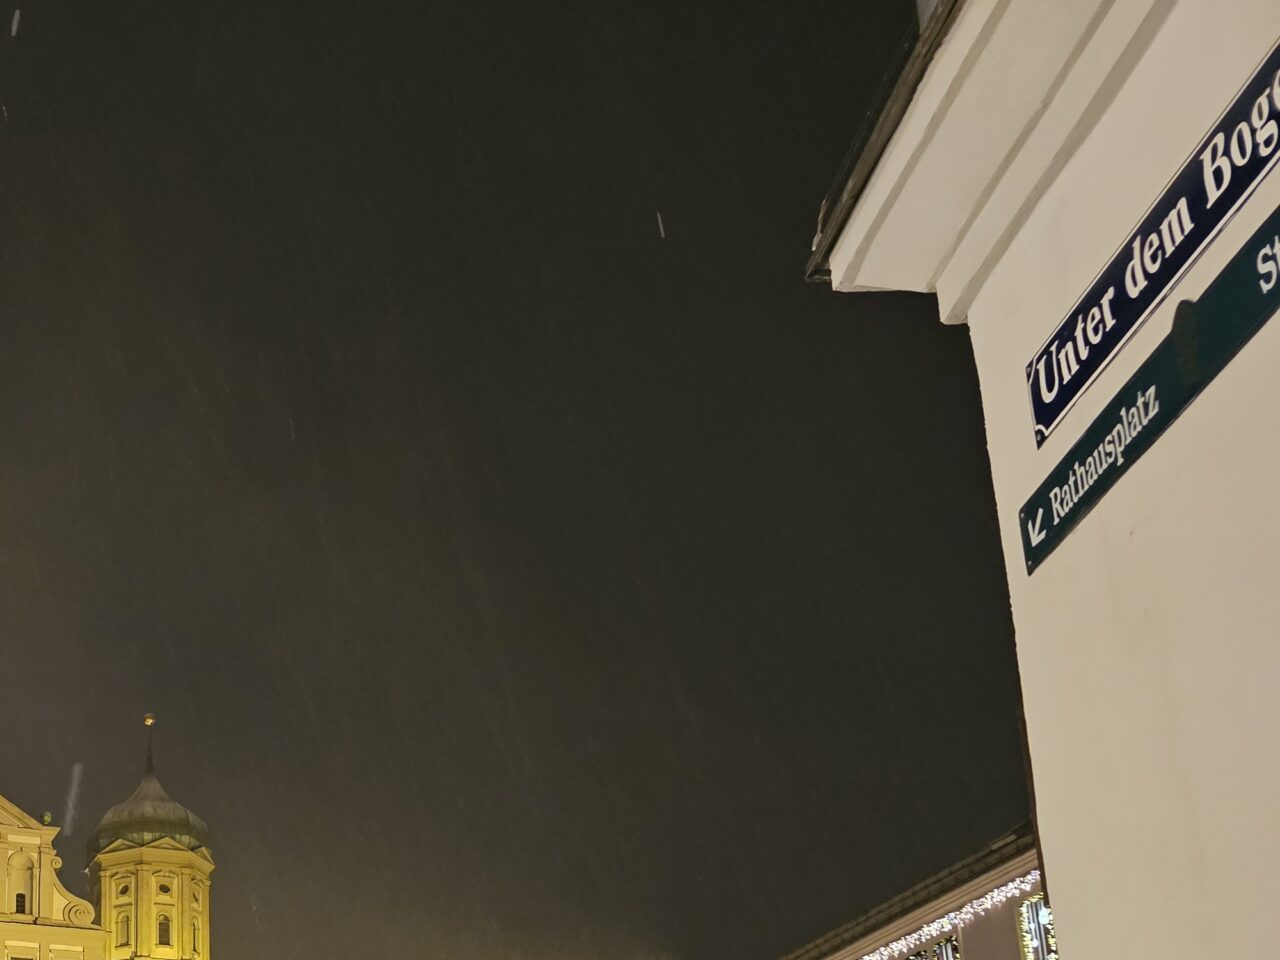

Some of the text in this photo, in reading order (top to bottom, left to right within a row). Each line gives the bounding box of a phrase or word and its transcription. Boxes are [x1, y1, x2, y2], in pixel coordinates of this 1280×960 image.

[1035, 286, 1117, 404] Unter
[1124, 197, 1195, 299] dem
[1048, 384, 1160, 525] Rathausplatz
